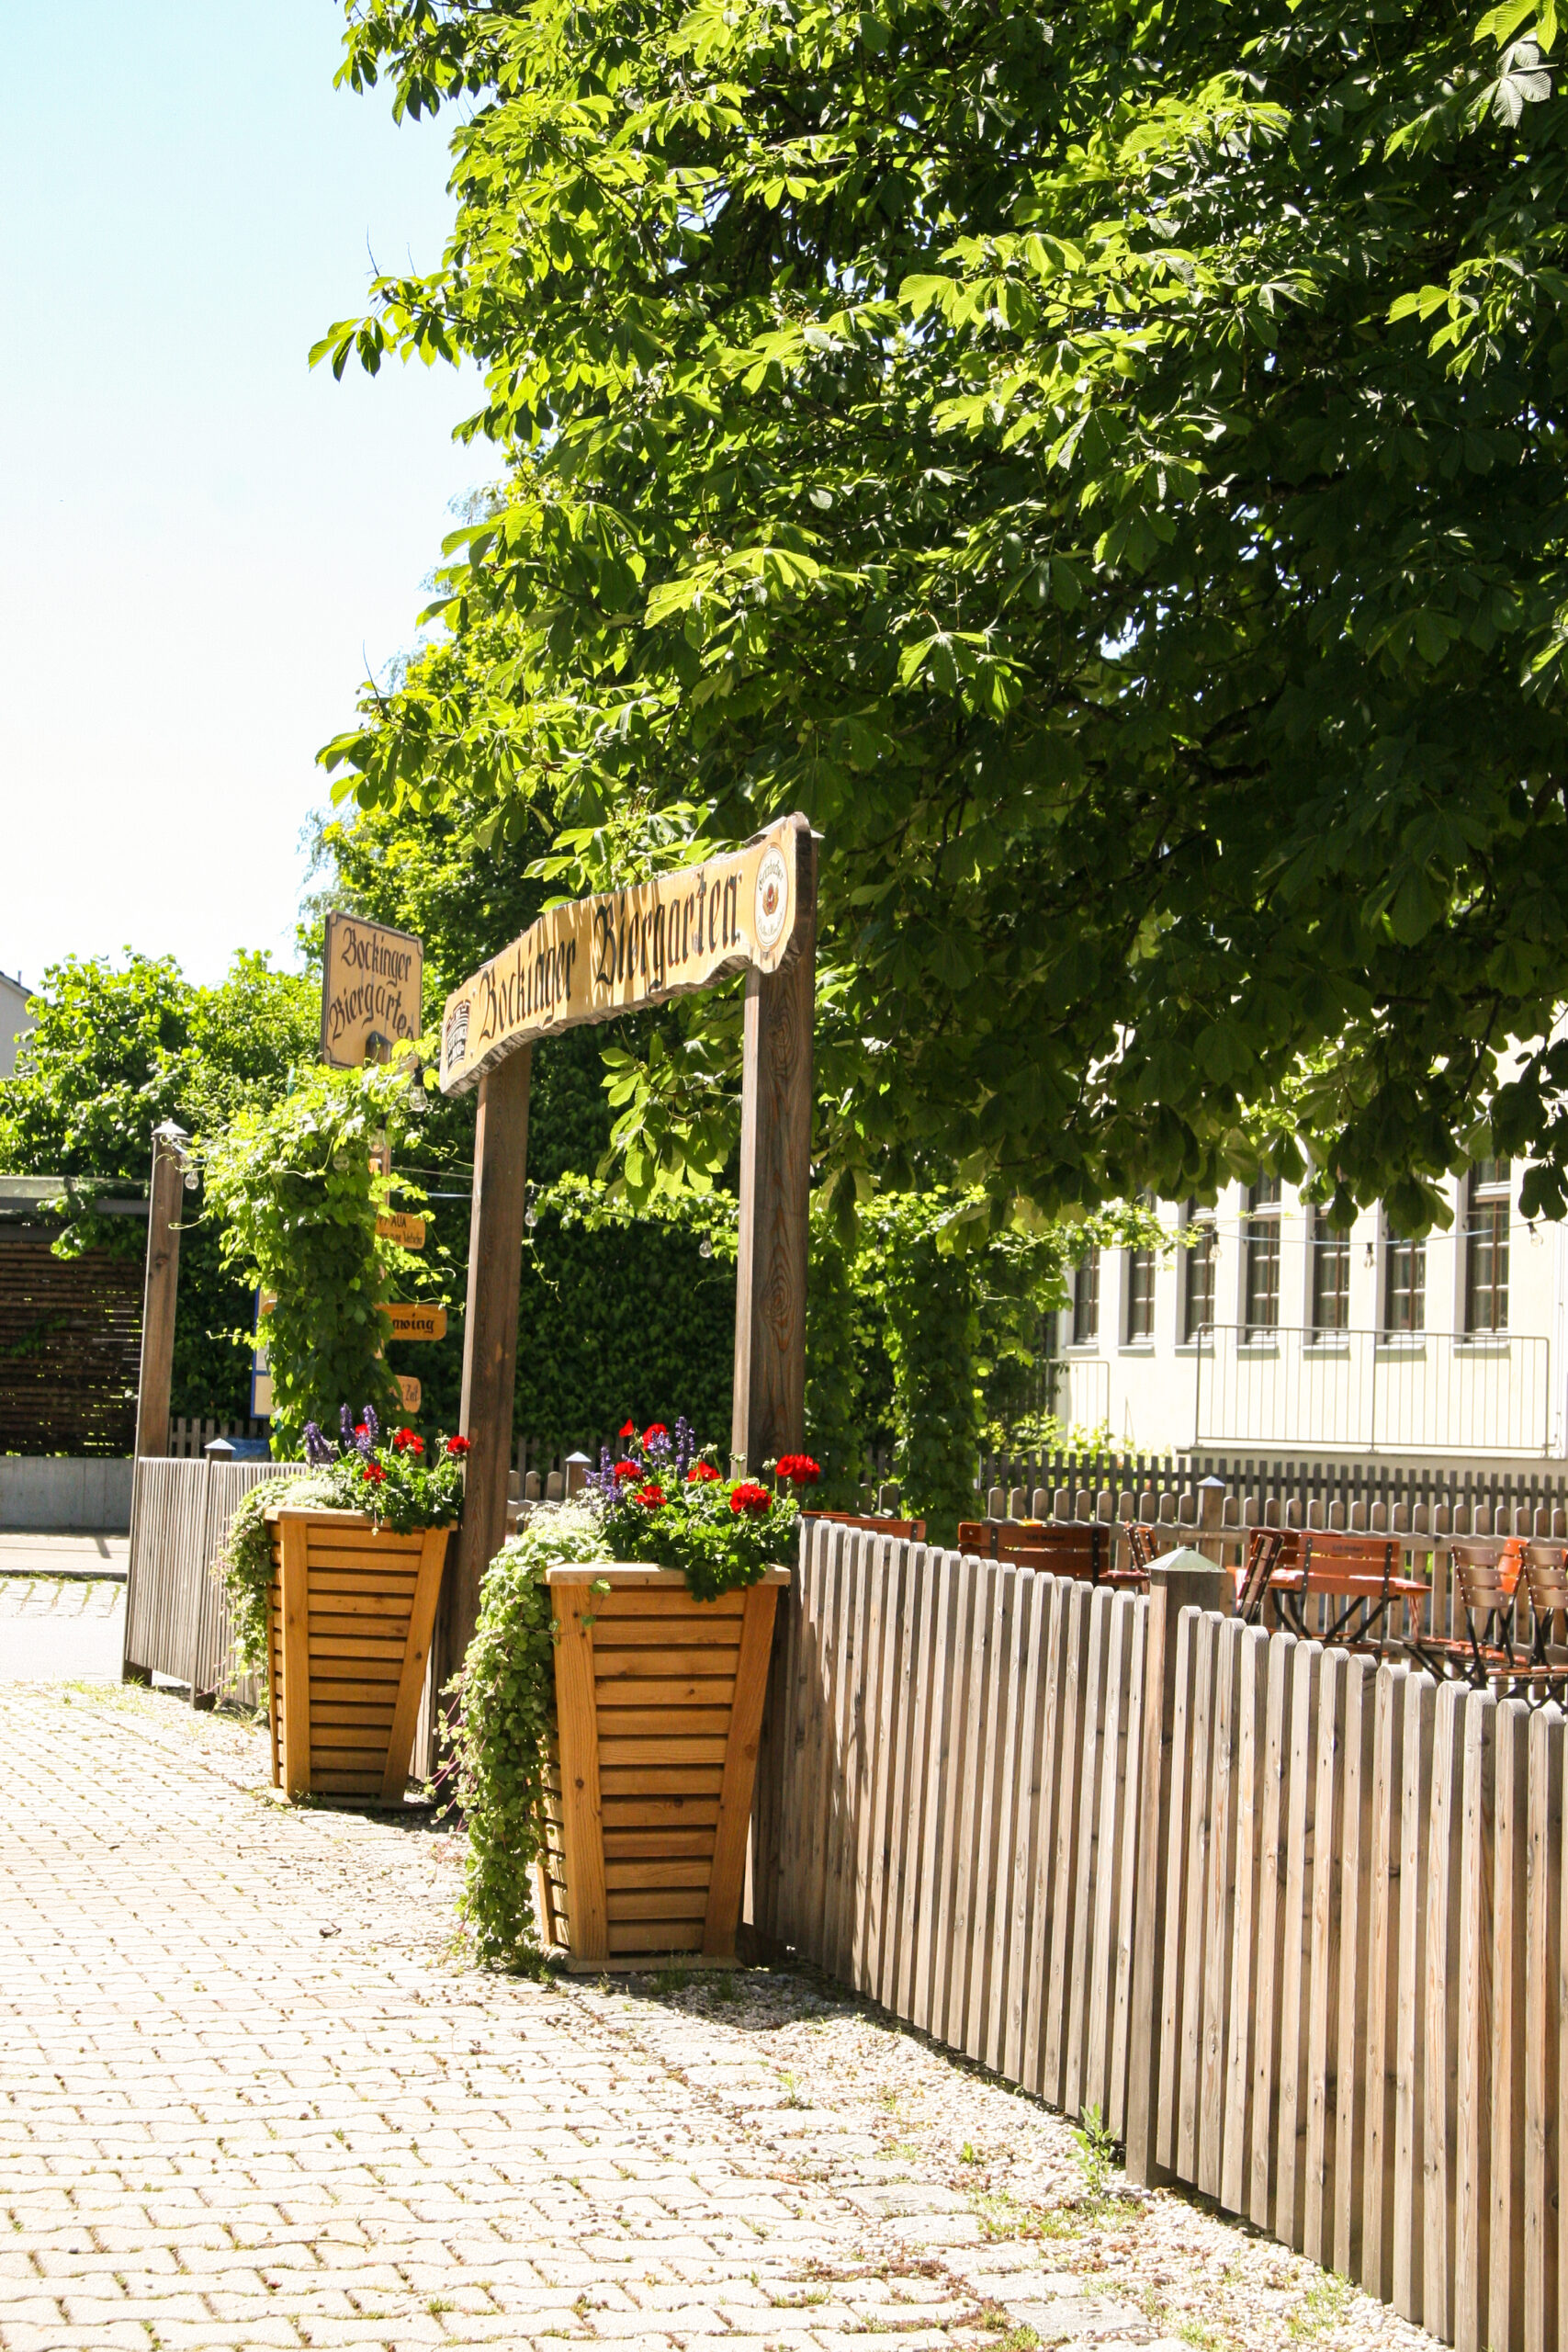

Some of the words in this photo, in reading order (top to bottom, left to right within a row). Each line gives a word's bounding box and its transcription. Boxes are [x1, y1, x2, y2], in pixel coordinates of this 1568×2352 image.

[341, 926, 412, 988] Bockinger
[478, 933, 577, 1046] Bockinger
[592, 867, 740, 994] Biergarten
[329, 983, 414, 1043] Biergarten
